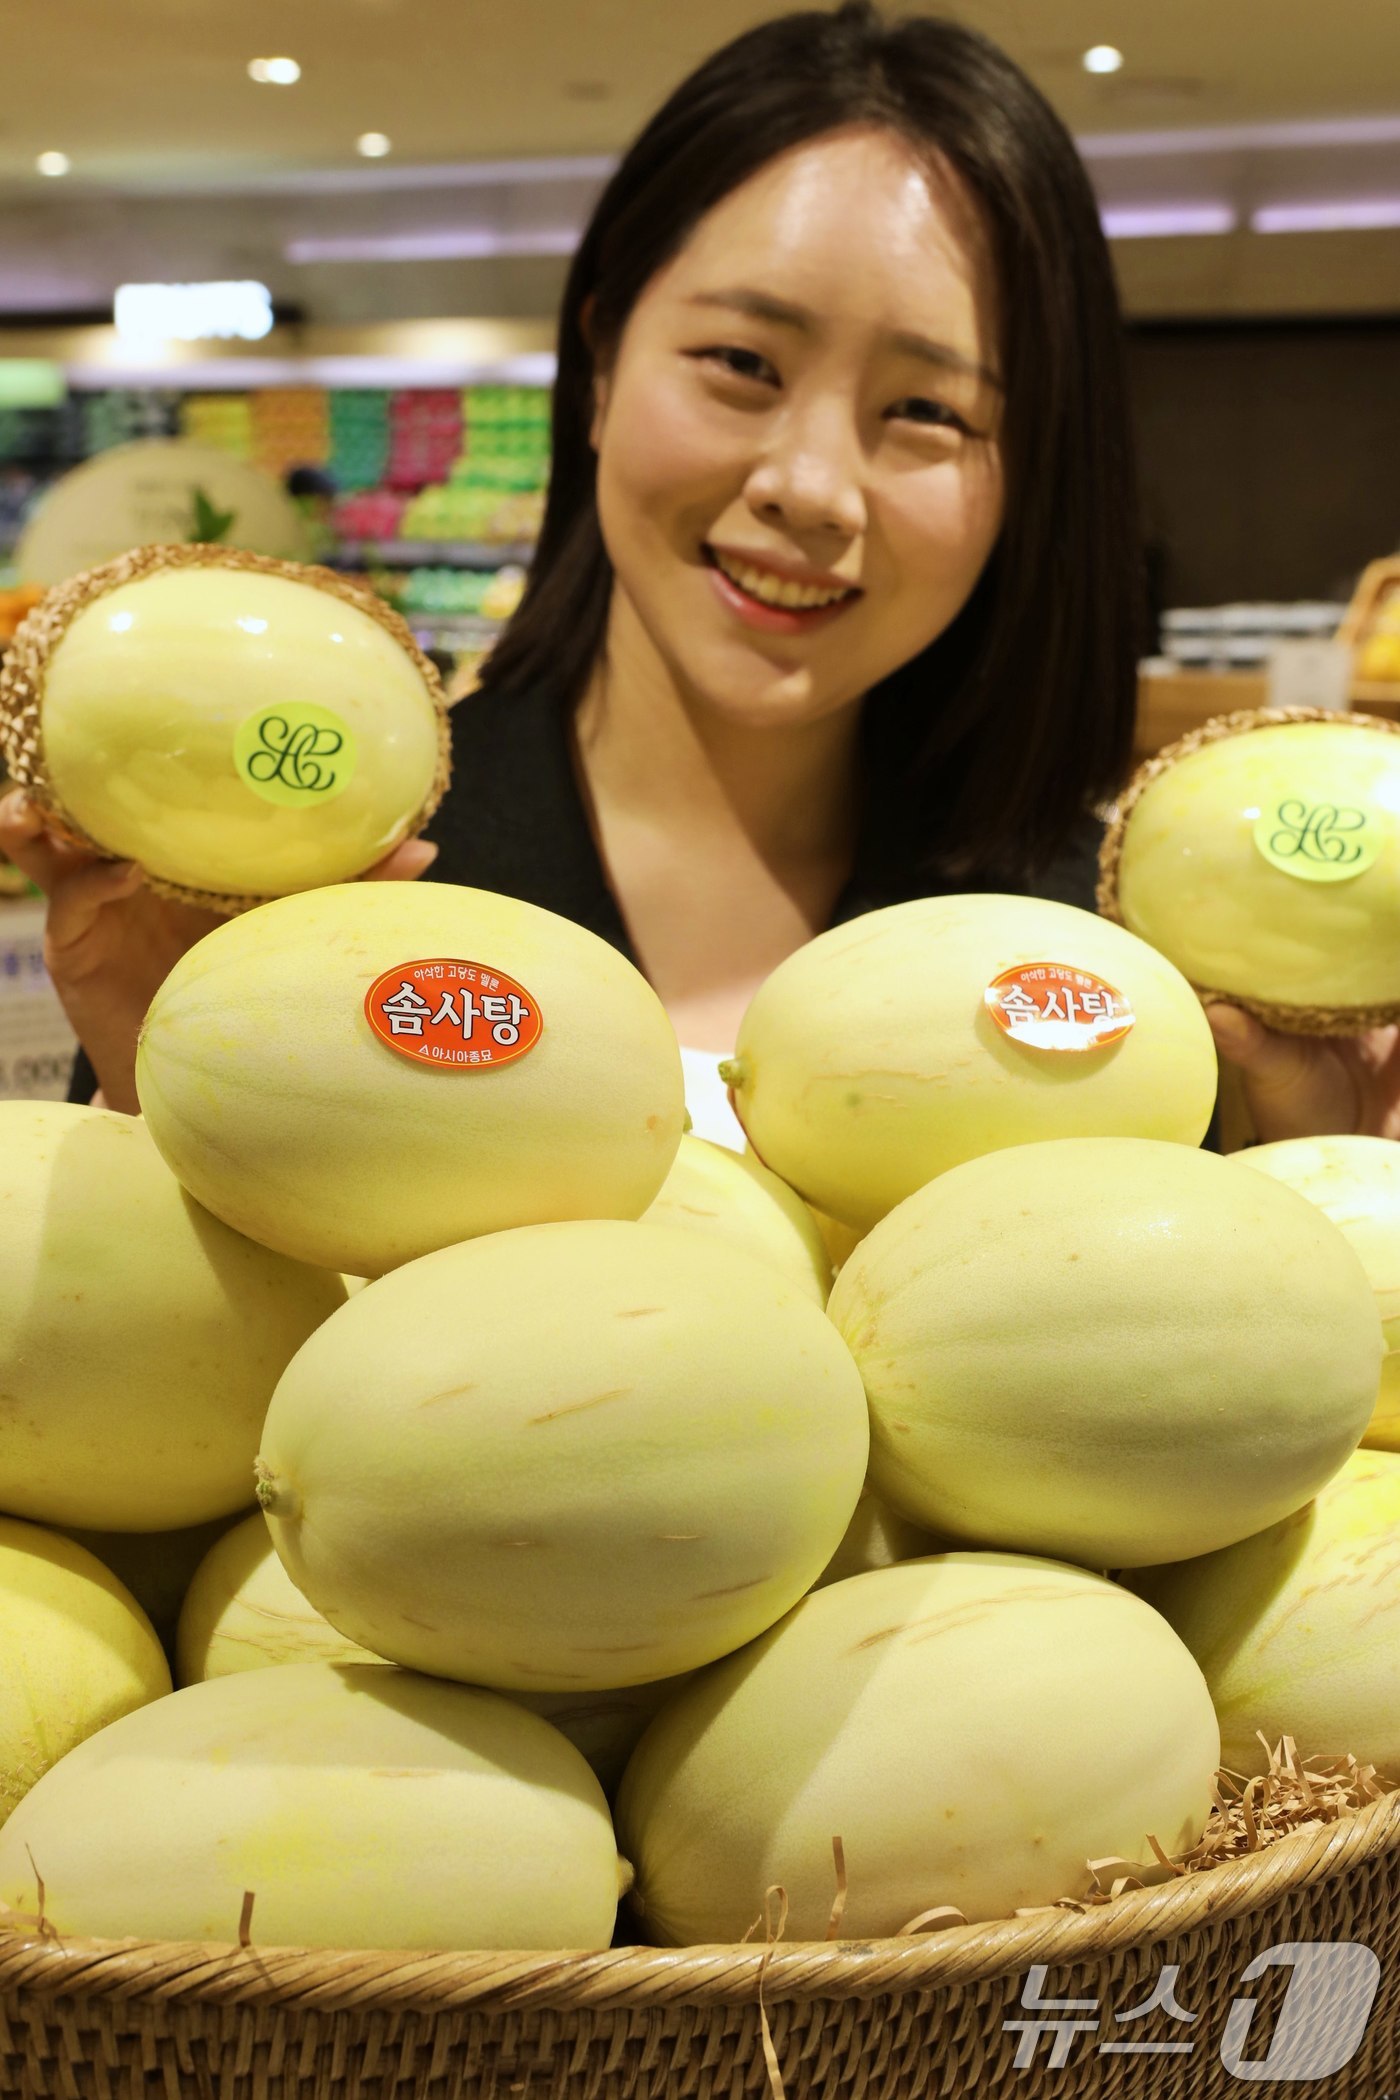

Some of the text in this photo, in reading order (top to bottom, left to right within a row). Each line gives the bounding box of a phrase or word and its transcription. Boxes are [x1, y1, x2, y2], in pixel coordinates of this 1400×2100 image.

[414, 965, 500, 992] 아삭한 고당도 멜론
[381, 980, 530, 1046] 솜사탕
[1000, 984, 1120, 1032] 솜사탕
[432, 1046, 493, 1063] 아시아종묘
